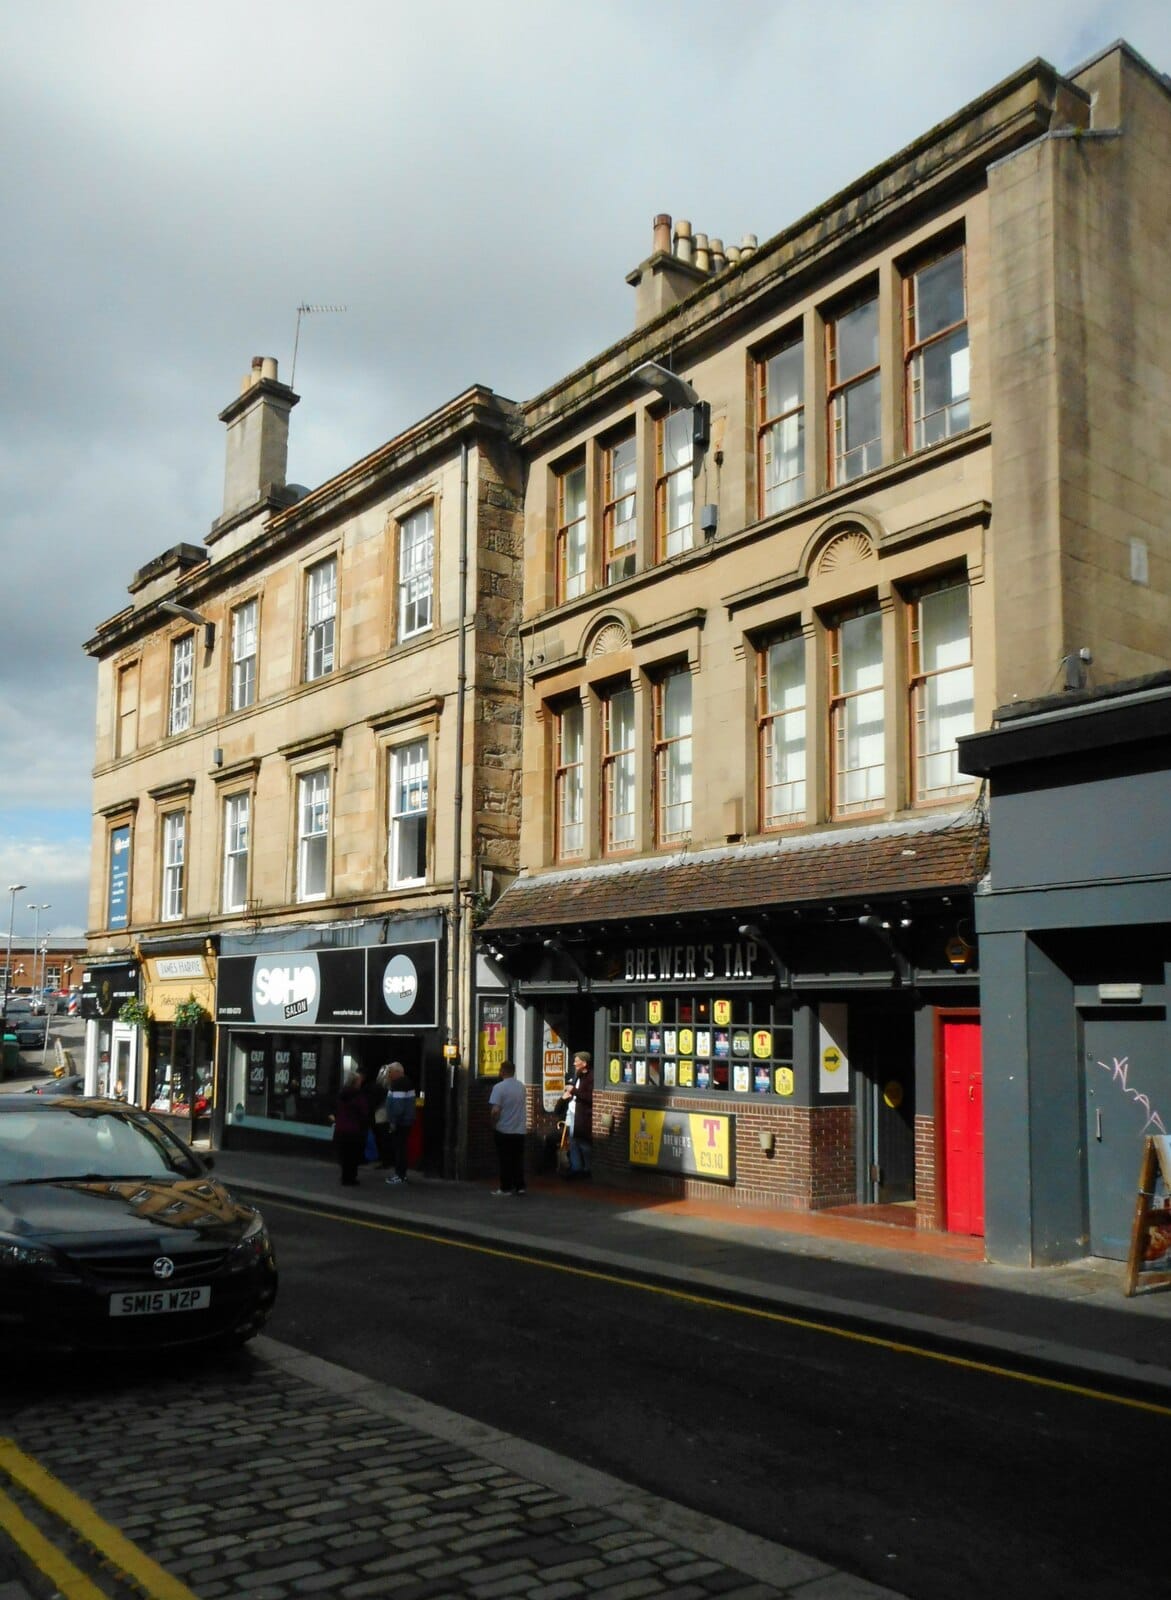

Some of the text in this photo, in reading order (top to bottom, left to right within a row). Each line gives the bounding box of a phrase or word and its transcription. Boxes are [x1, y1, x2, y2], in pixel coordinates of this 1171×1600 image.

[625, 942, 757, 980] BREWER'S TAP
[255, 966, 316, 1006] SOHO
[384, 975, 416, 994] SOHO
[285, 999, 307, 1018] SALON
[652, 1002, 658, 1013] T
[718, 1001, 727, 1013] T
[483, 1022, 502, 1046] T
[625, 1031, 631, 1042] T
[758, 1033, 767, 1046] T
[545, 1052, 563, 1064] LIVE
[663, 1134, 691, 1148] BREWER'S
[703, 1118, 720, 1147] T
[700, 1151, 723, 1169] £3.10
[122, 1289, 200, 1313] SM15 WZP
